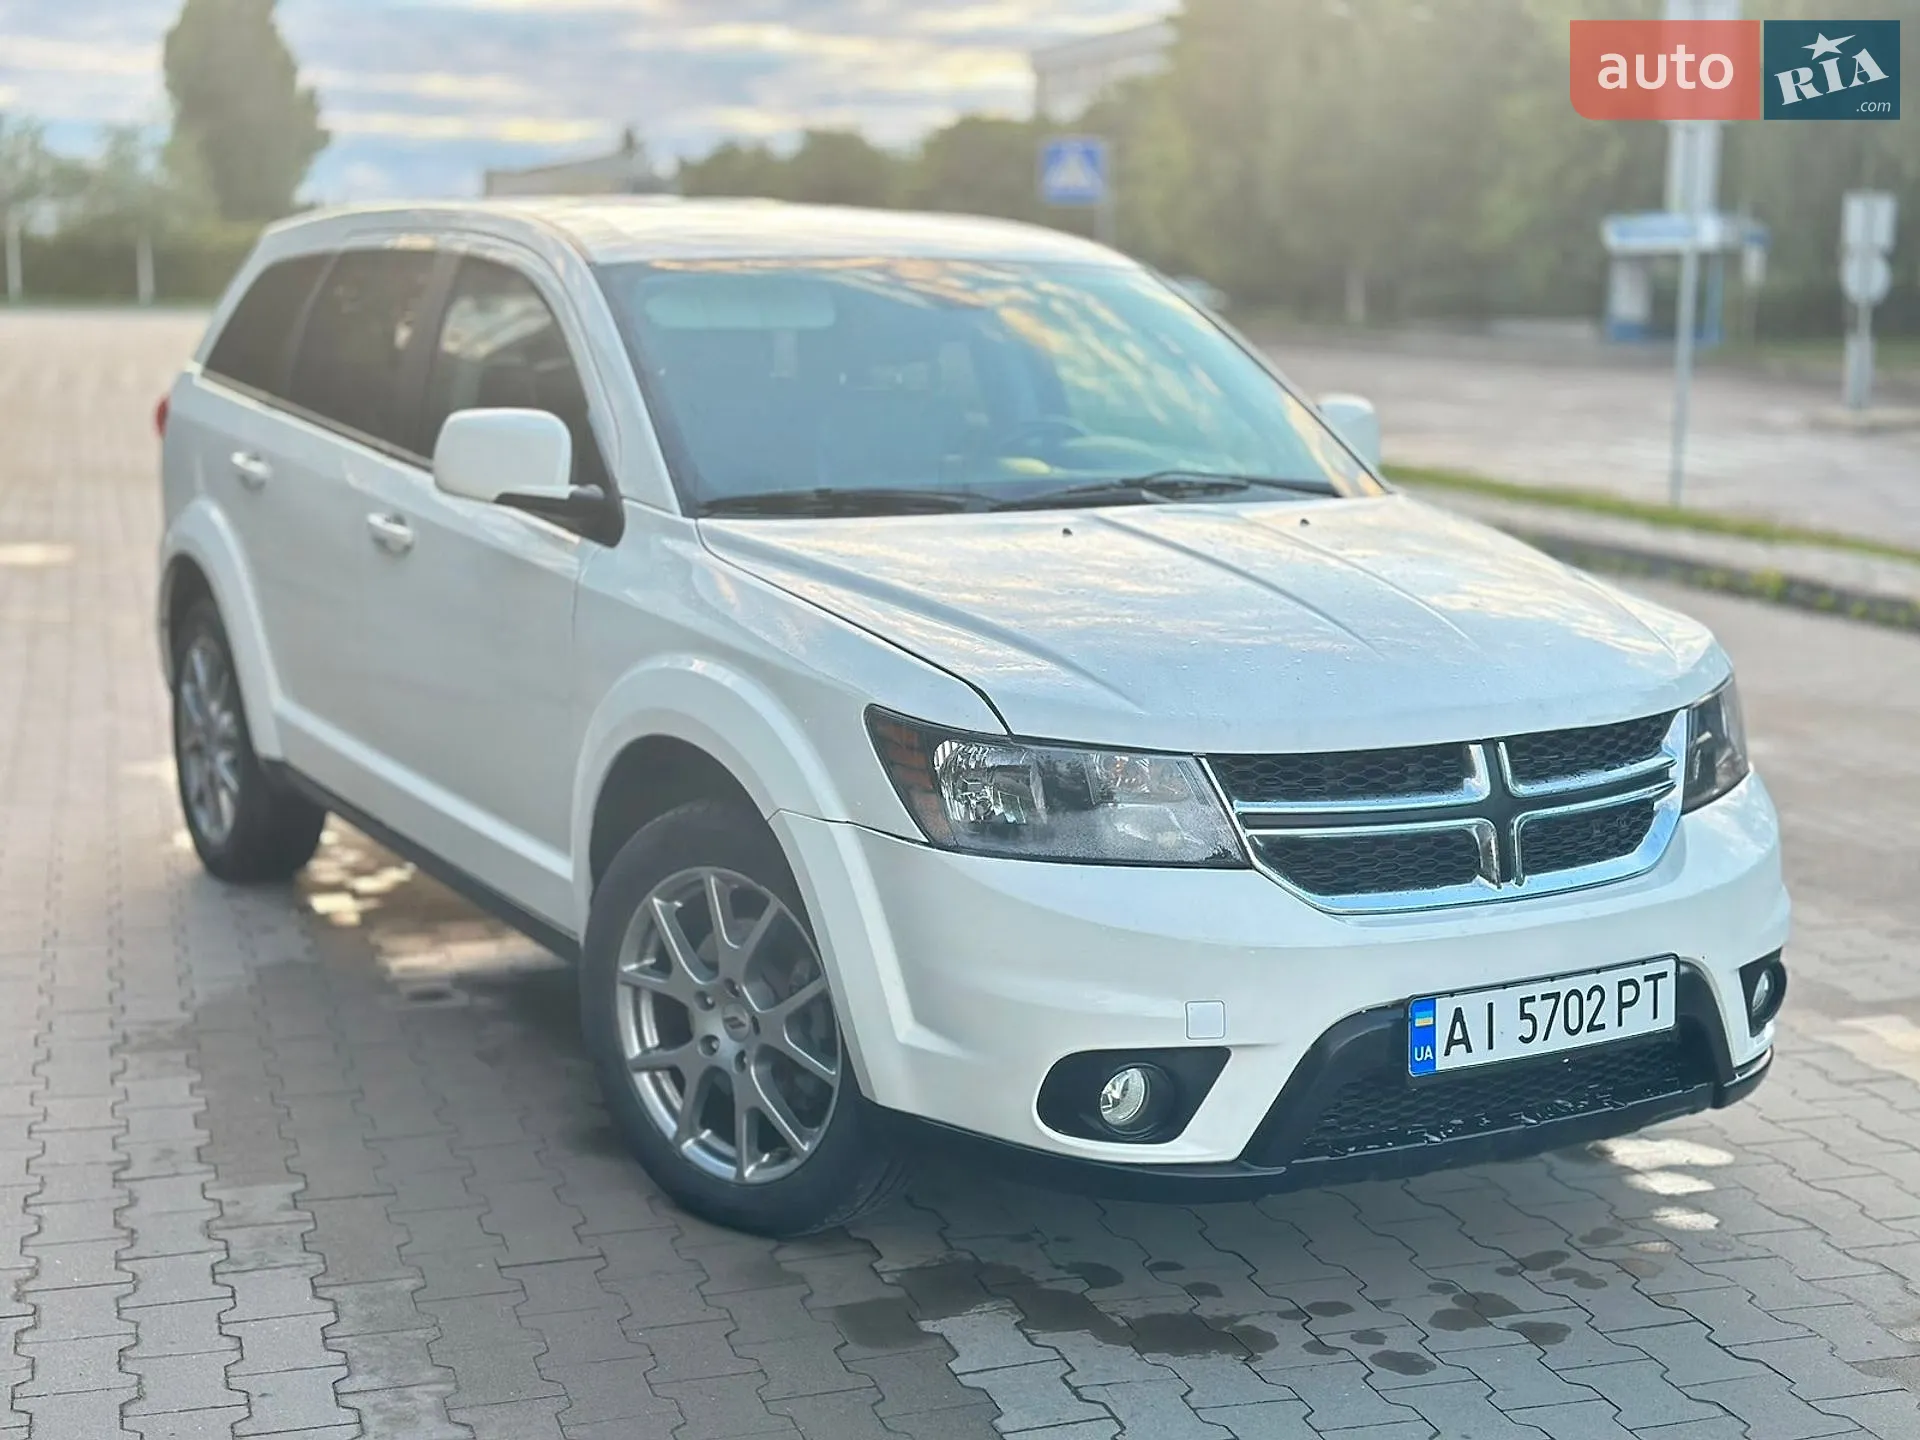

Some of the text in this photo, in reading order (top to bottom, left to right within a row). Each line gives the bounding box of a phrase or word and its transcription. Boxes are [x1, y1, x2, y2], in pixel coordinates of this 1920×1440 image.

[1443, 971, 1668, 1056] AI 5702 PT
[1414, 1045, 1434, 1062] UA
